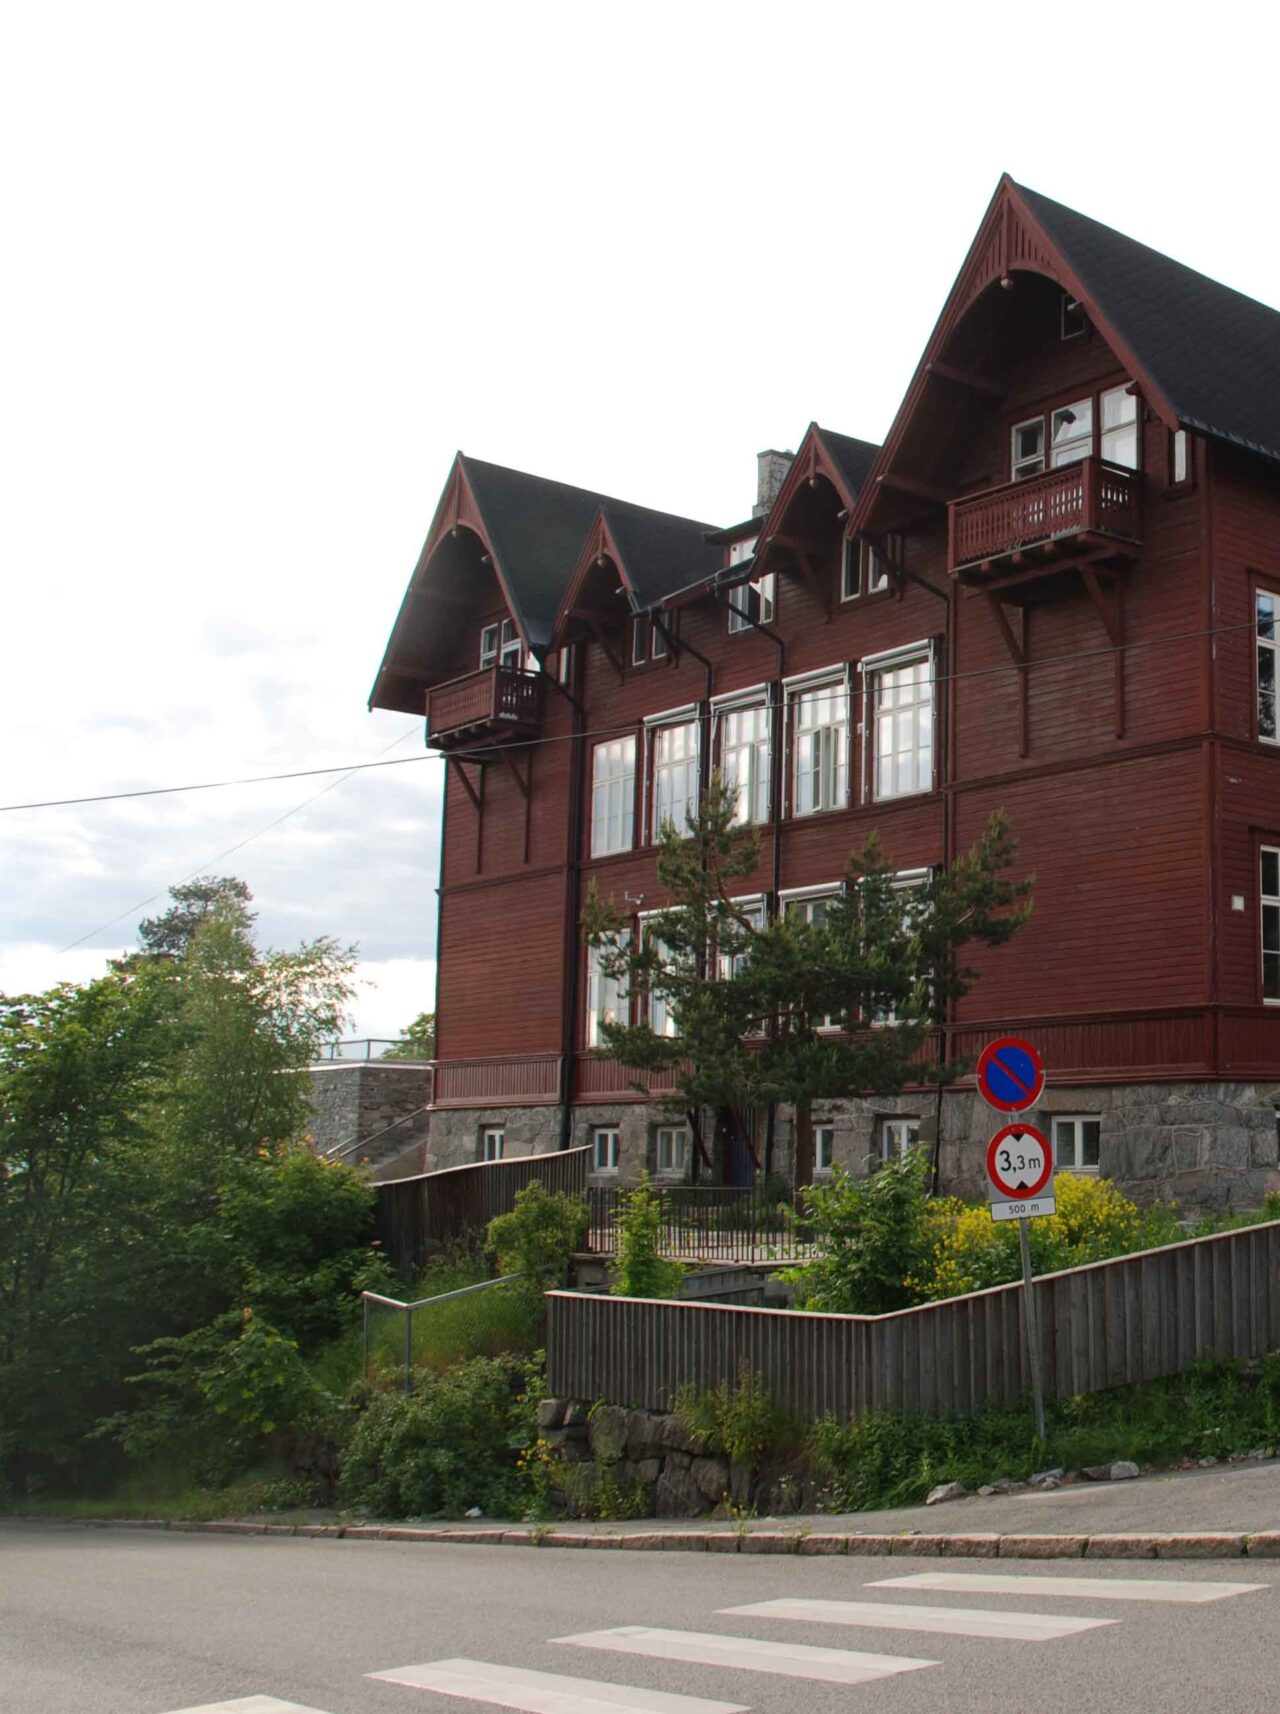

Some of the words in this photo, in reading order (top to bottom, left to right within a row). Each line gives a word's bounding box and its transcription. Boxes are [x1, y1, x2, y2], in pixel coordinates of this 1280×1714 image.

[999, 1150, 1025, 1173] 3,3
[1028, 1157, 1041, 1168] m
[1008, 1204, 1026, 1214] 500
[1031, 1203, 1040, 1211] m
